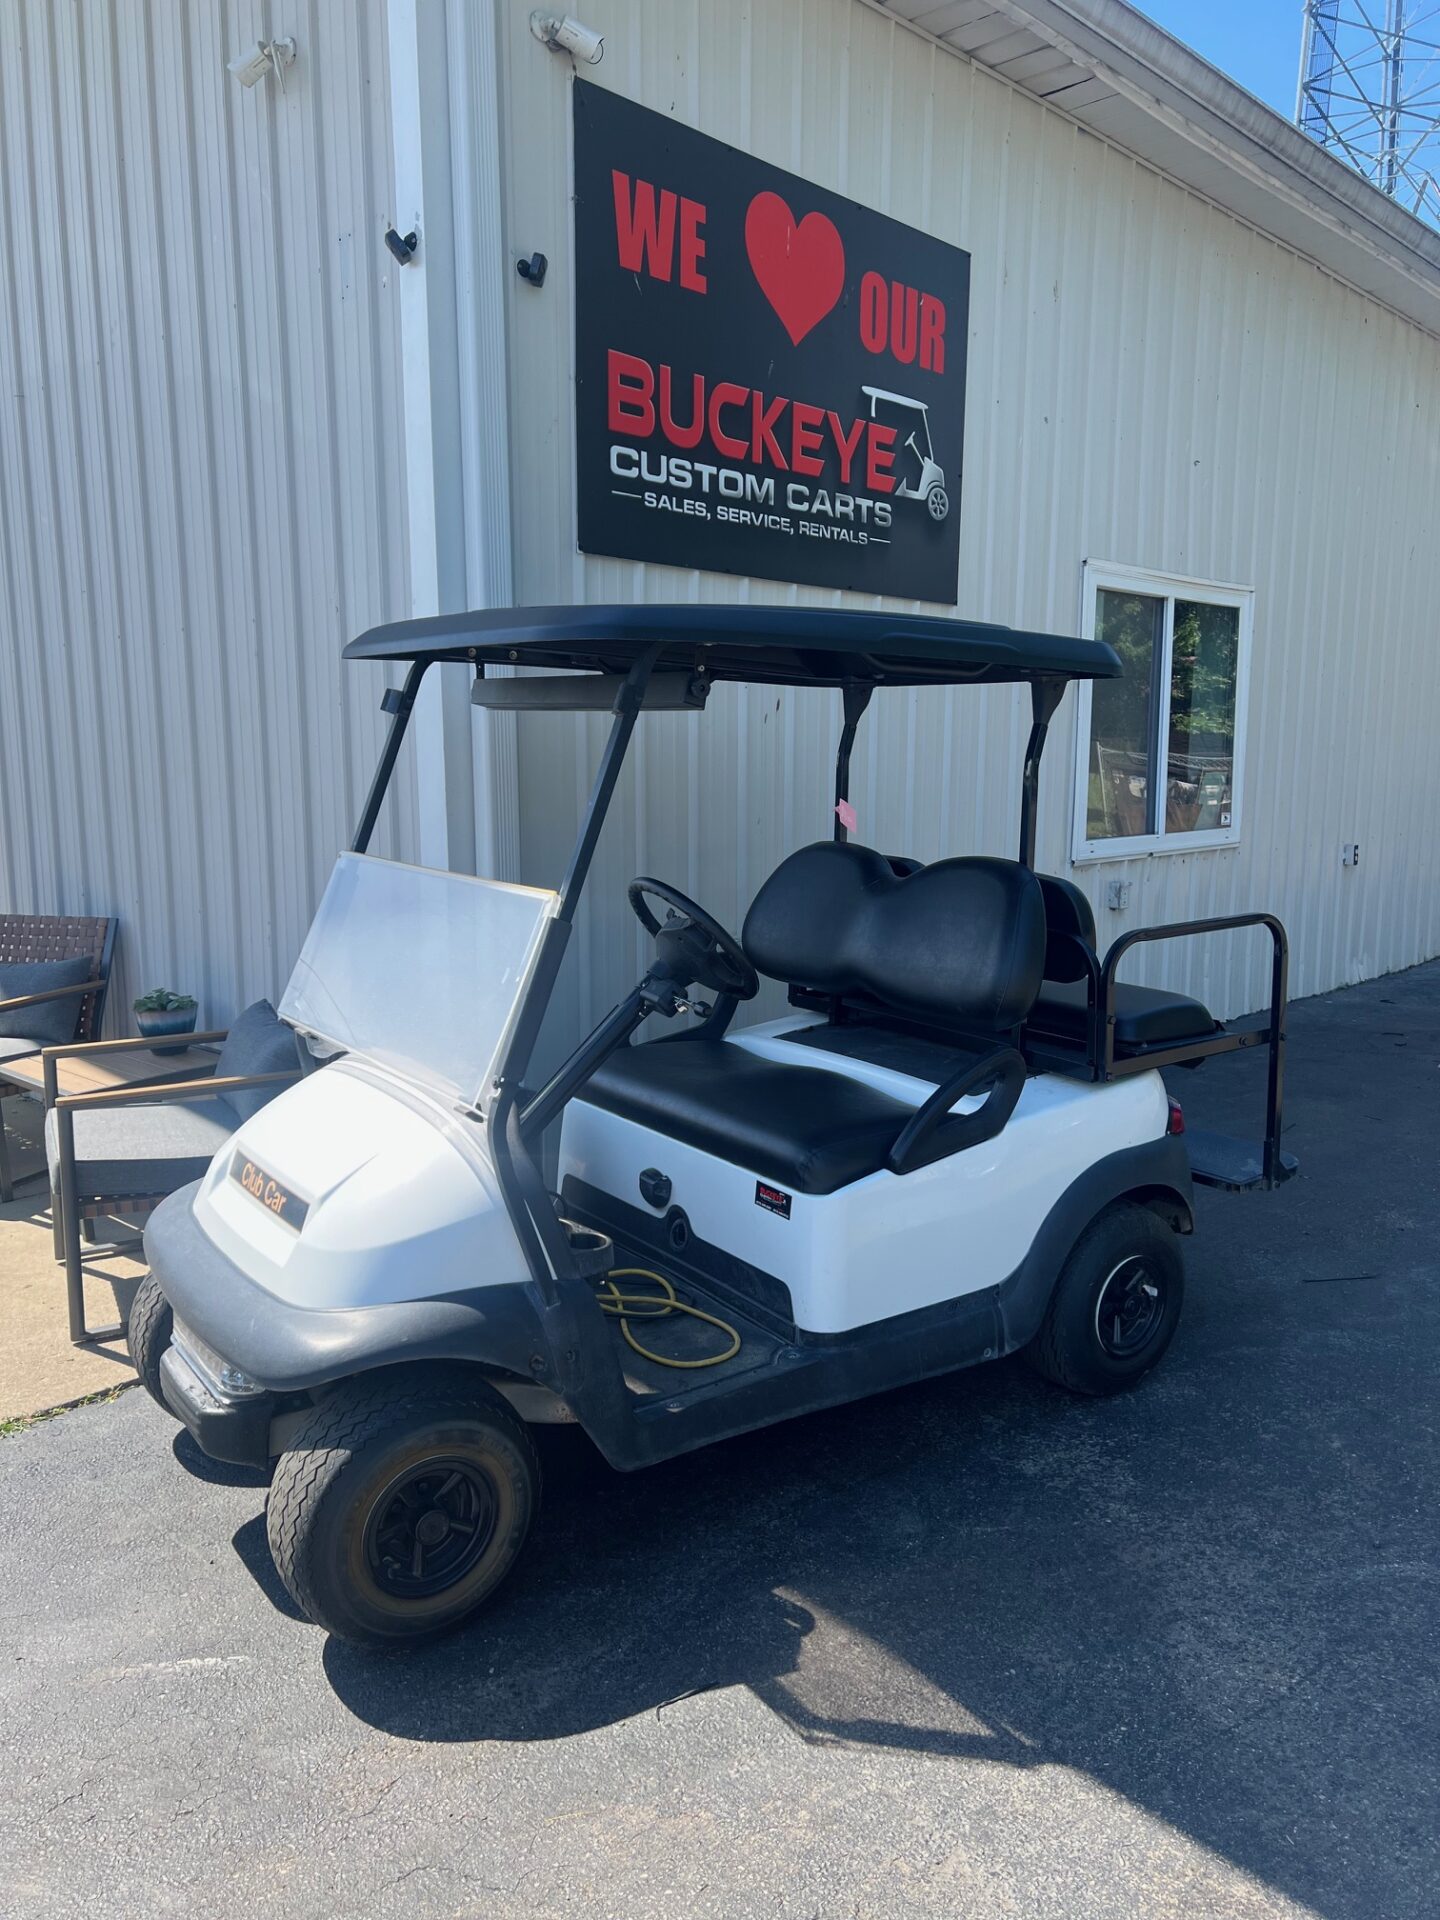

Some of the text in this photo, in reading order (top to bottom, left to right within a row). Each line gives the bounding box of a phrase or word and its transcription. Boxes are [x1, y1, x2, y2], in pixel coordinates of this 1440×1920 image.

[611, 168, 946, 375] WE OUR
[607, 348, 898, 494] BUCKEYE
[609, 444, 892, 528] CUSTOM CARTS
[644, 491, 868, 545] SALES, SERVICE, RENTALS
[241, 1161, 287, 1214] Club Car
